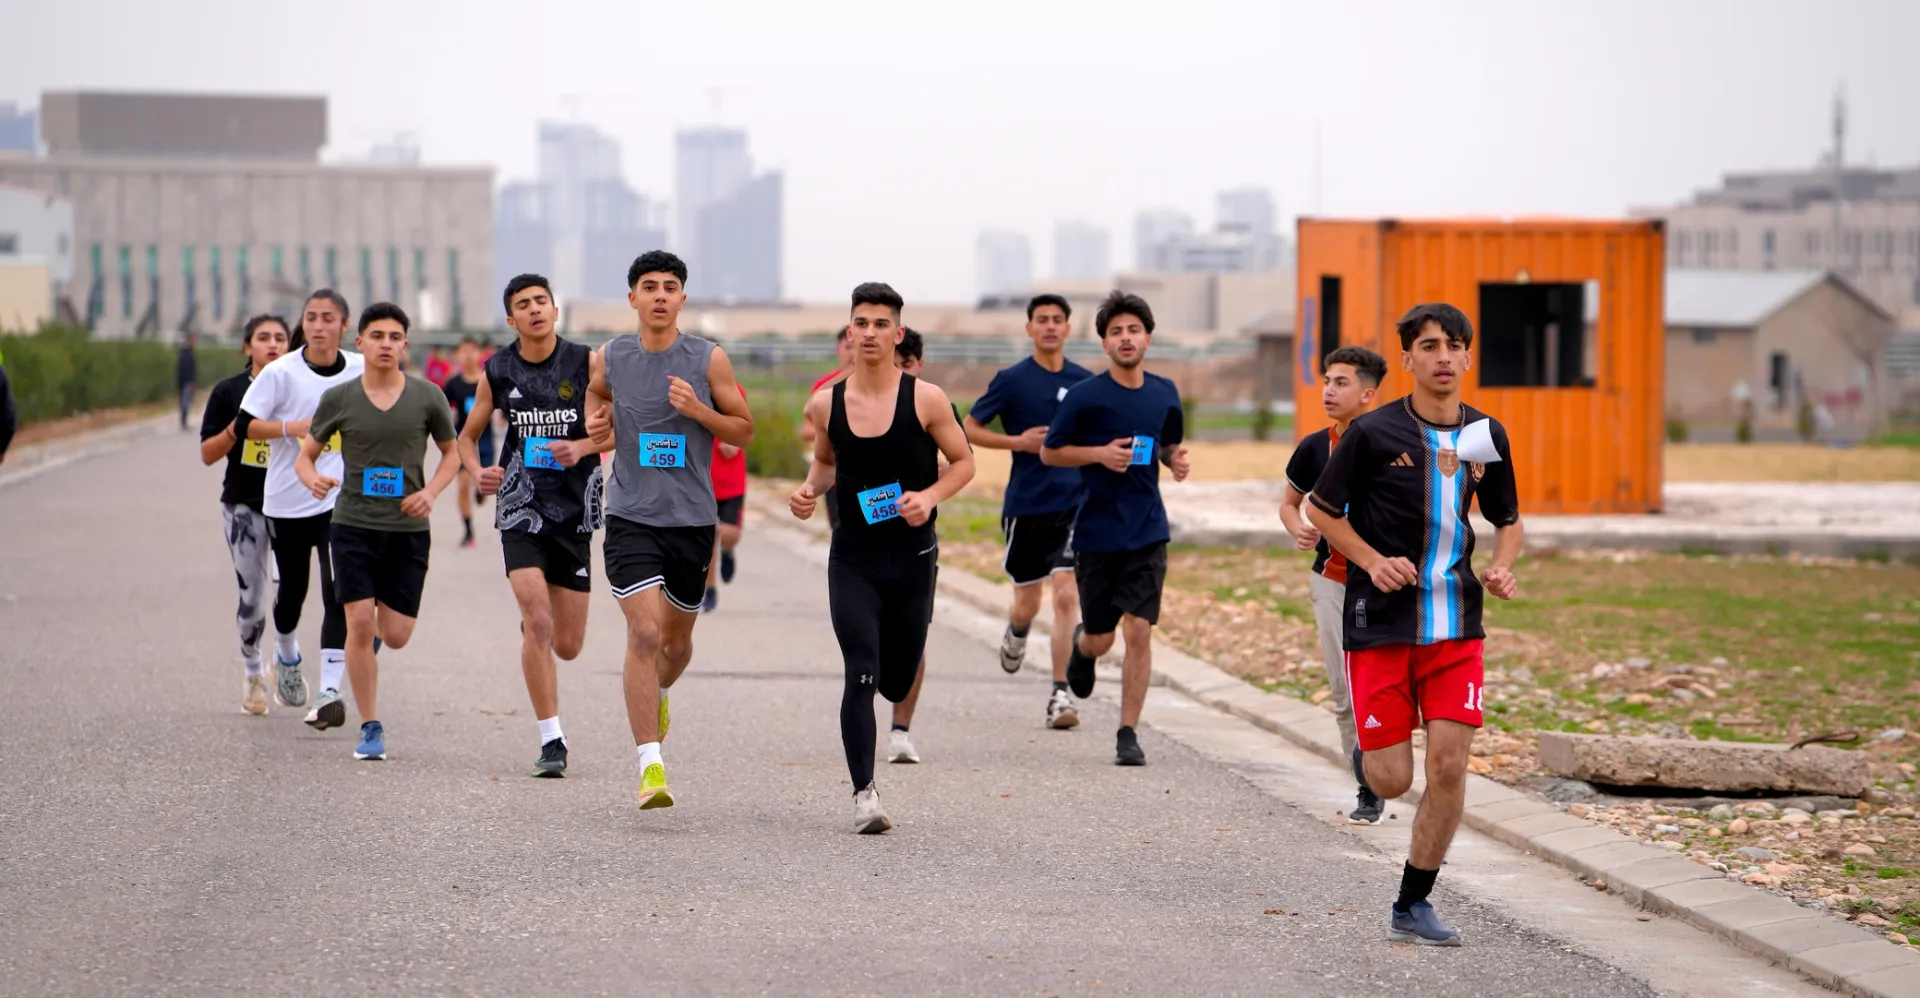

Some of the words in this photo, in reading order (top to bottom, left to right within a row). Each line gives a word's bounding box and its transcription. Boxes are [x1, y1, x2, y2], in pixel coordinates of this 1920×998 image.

[510, 407, 578, 425] Emirates
[518, 425, 533, 438] FLY
[535, 424, 569, 437] BETTER
[532, 456, 557, 467] 462
[649, 453, 676, 466] 459
[371, 483, 395, 495] 456
[872, 504, 897, 519] 458
